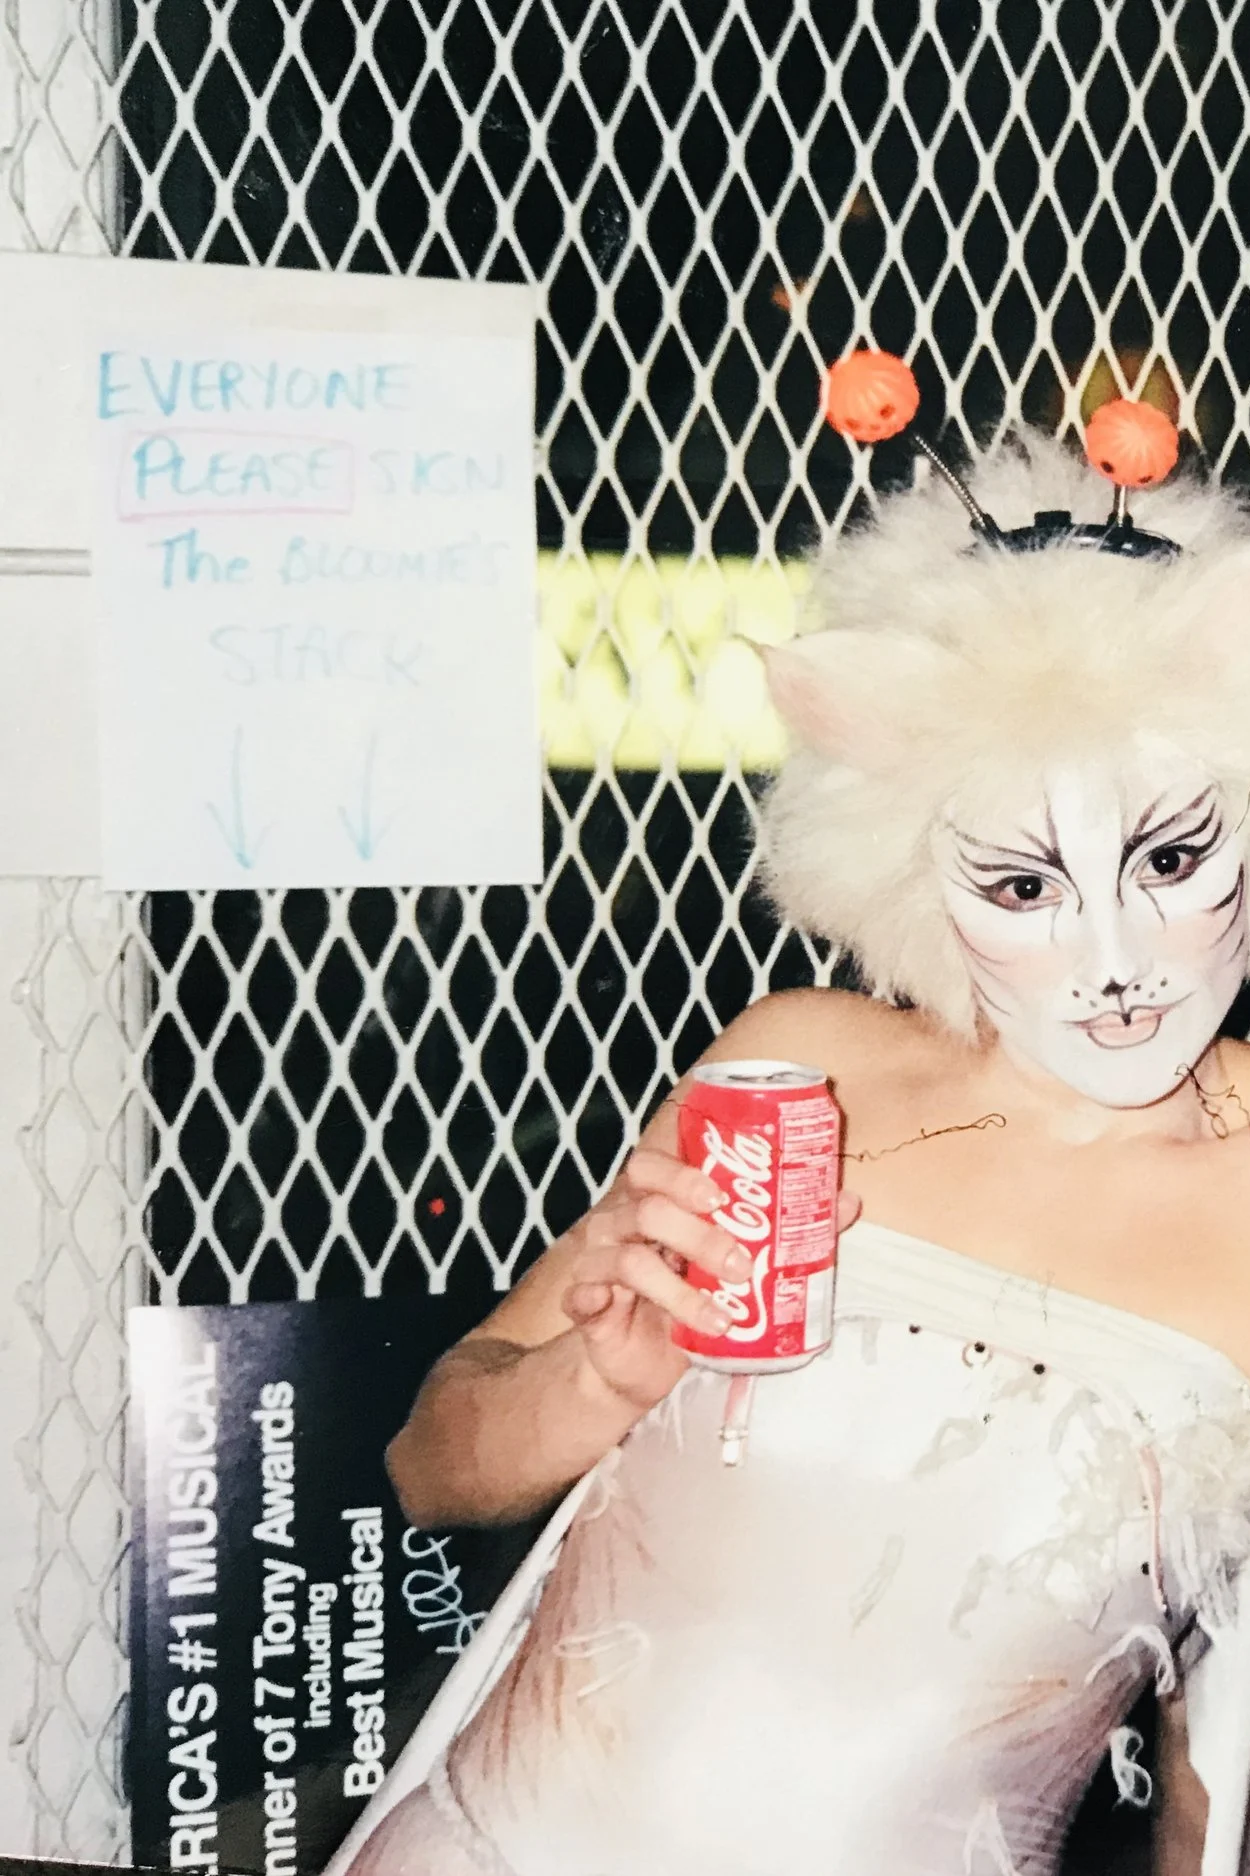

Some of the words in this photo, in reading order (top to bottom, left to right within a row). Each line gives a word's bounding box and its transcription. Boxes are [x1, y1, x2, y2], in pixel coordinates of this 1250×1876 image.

[98, 351, 413, 420] EVERYONE
[132, 434, 338, 500] PLEASE
[208, 623, 422, 688] STACK
[166, 1341, 219, 1597] MUSICAL
[250, 1380, 295, 1548] Awards
[167, 1613, 217, 1673] #1
[252, 1558, 306, 1669] Tony
[340, 1506, 385, 1682] Musical
[254, 1677, 296, 1708] 7
[302, 1582, 338, 1729] including
[167, 1682, 219, 1876] RICA'S
[253, 1714, 297, 1763] of
[343, 1688, 386, 1797] Best
